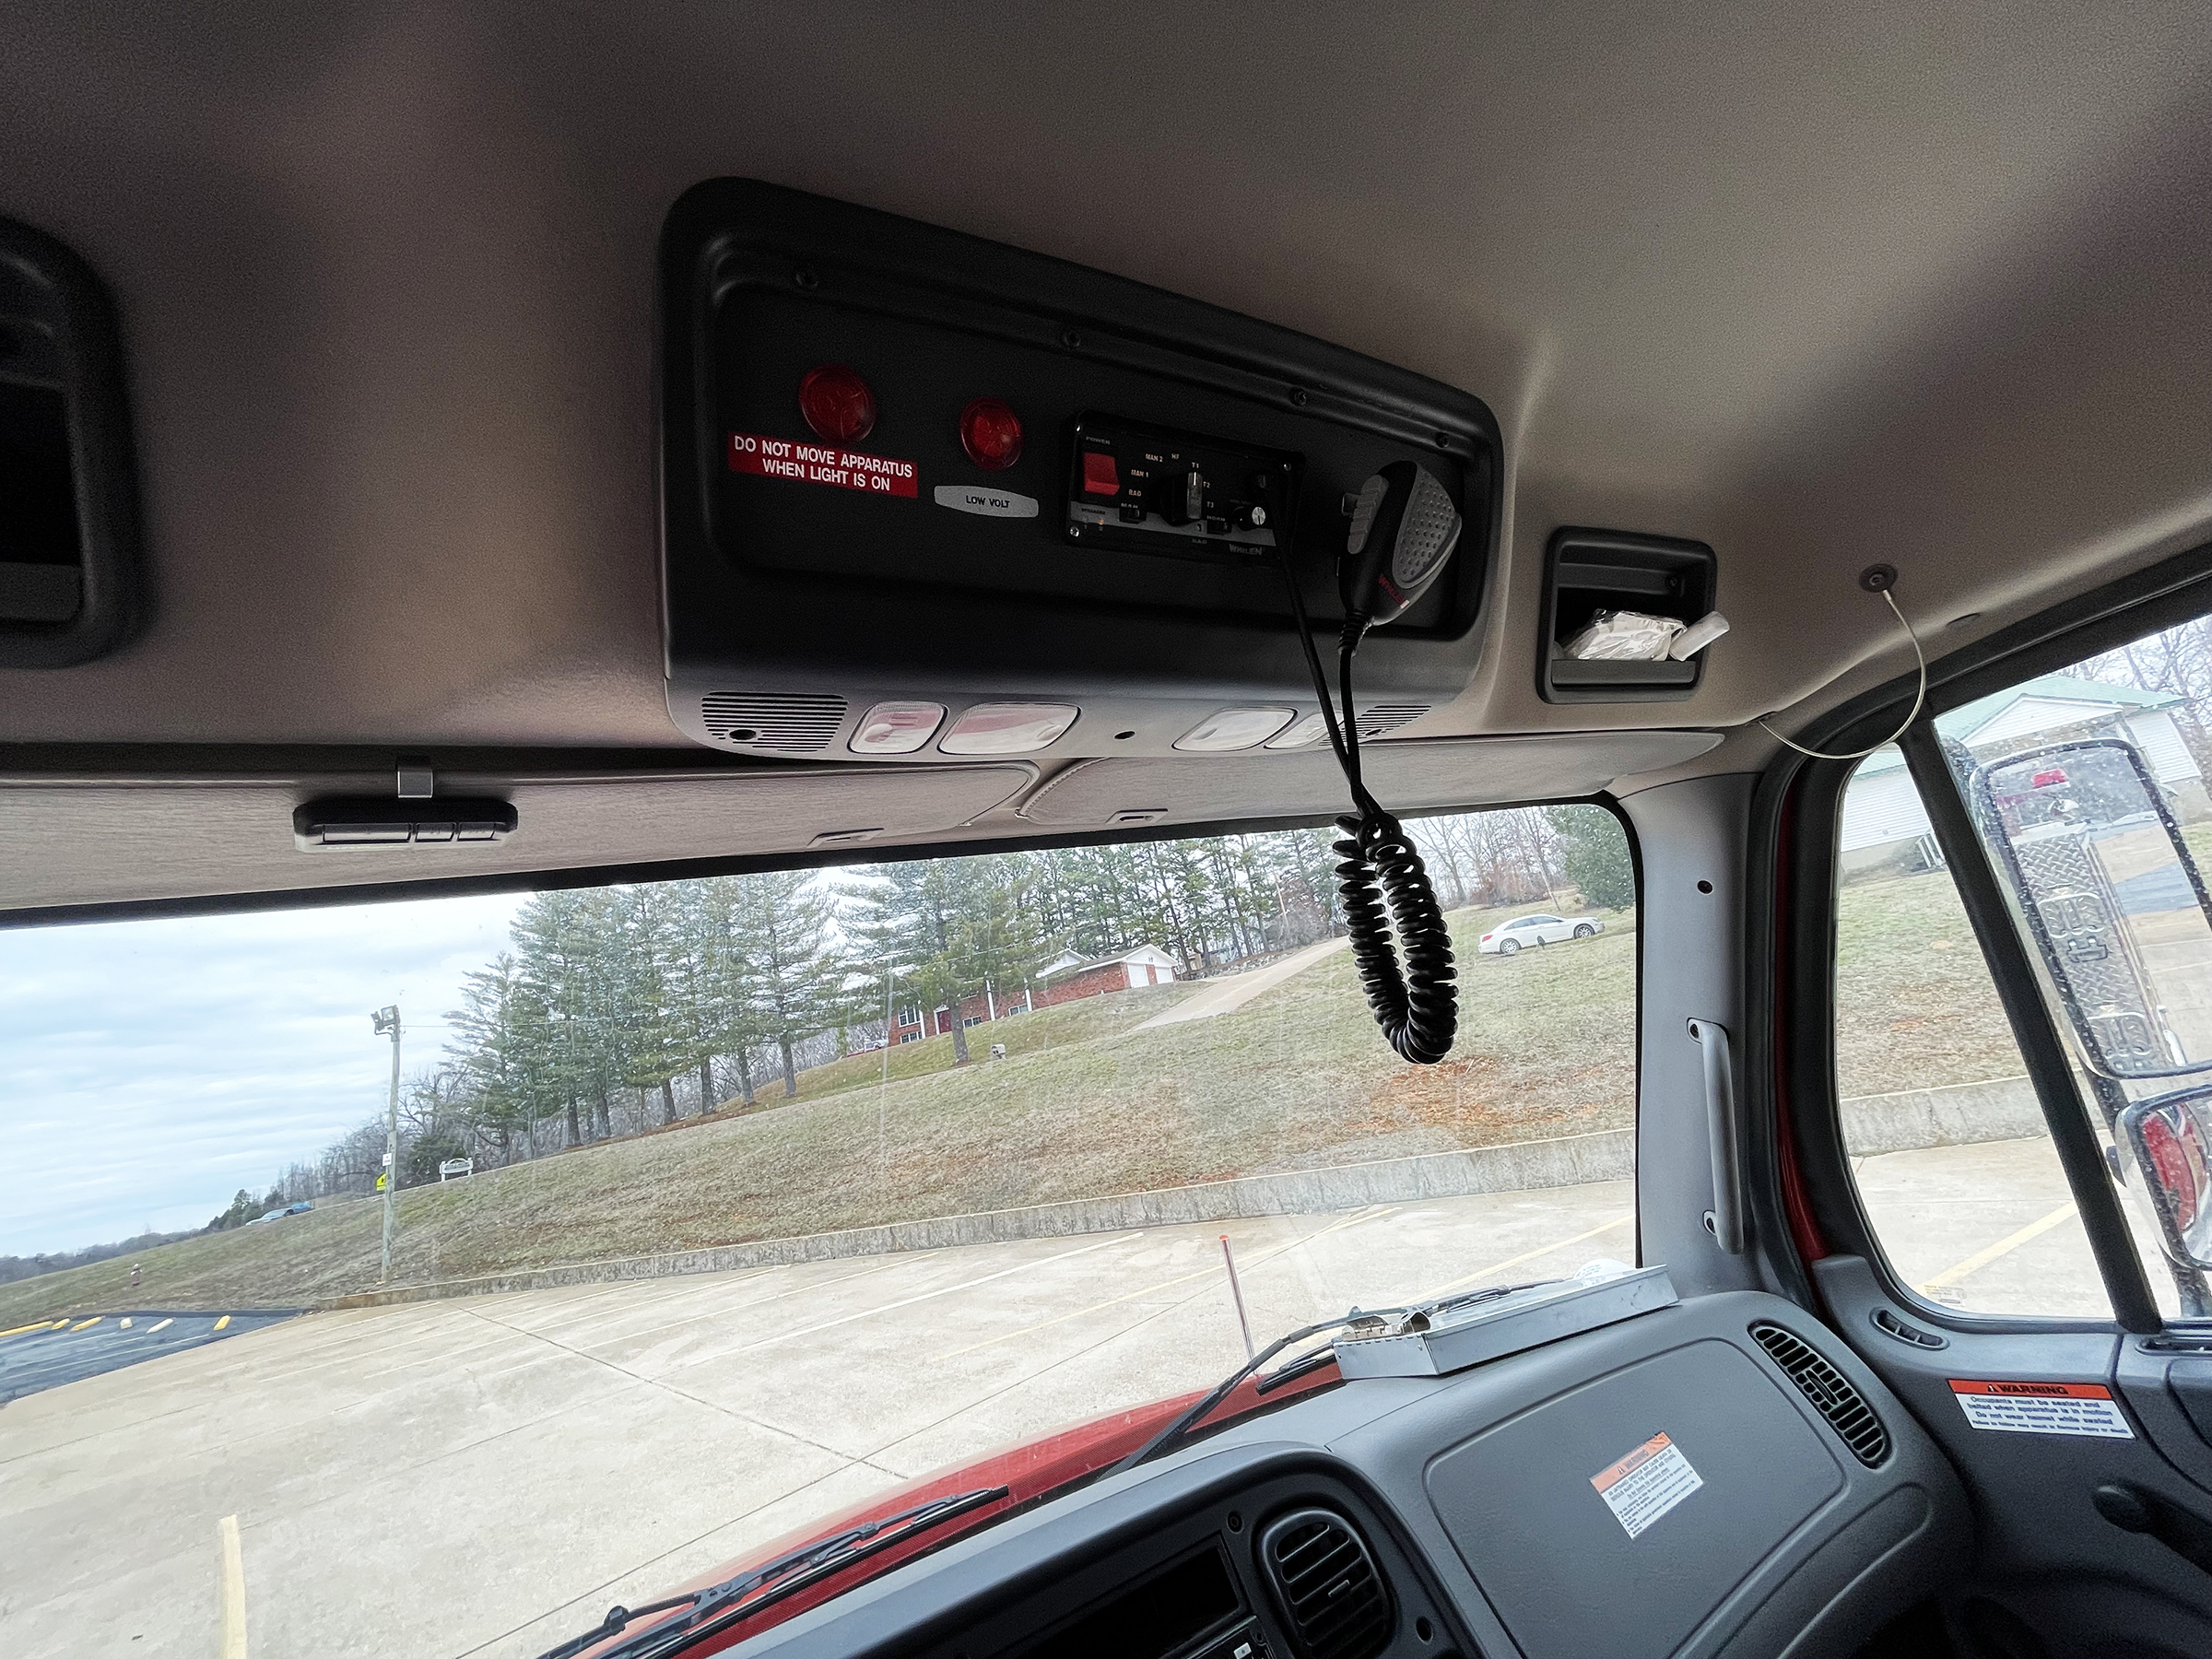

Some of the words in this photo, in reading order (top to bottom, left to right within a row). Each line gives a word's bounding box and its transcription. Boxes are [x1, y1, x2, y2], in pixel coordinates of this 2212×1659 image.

[735, 435, 756, 453] DO
[762, 441, 791, 458] NOT
[796, 446, 835, 465] MOVE
[840, 453, 912, 478] APPARATUS
[762, 458, 805, 478] WHEN
[810, 465, 848, 486] LIGHT
[853, 472, 866, 488] IS
[871, 476, 890, 491] ON
[966, 495, 985, 506] LOW
[989, 498, 1011, 509] VOLT
[1206, 500, 1215, 509] T3
[1998, 1385, 2069, 1394] WARNING
